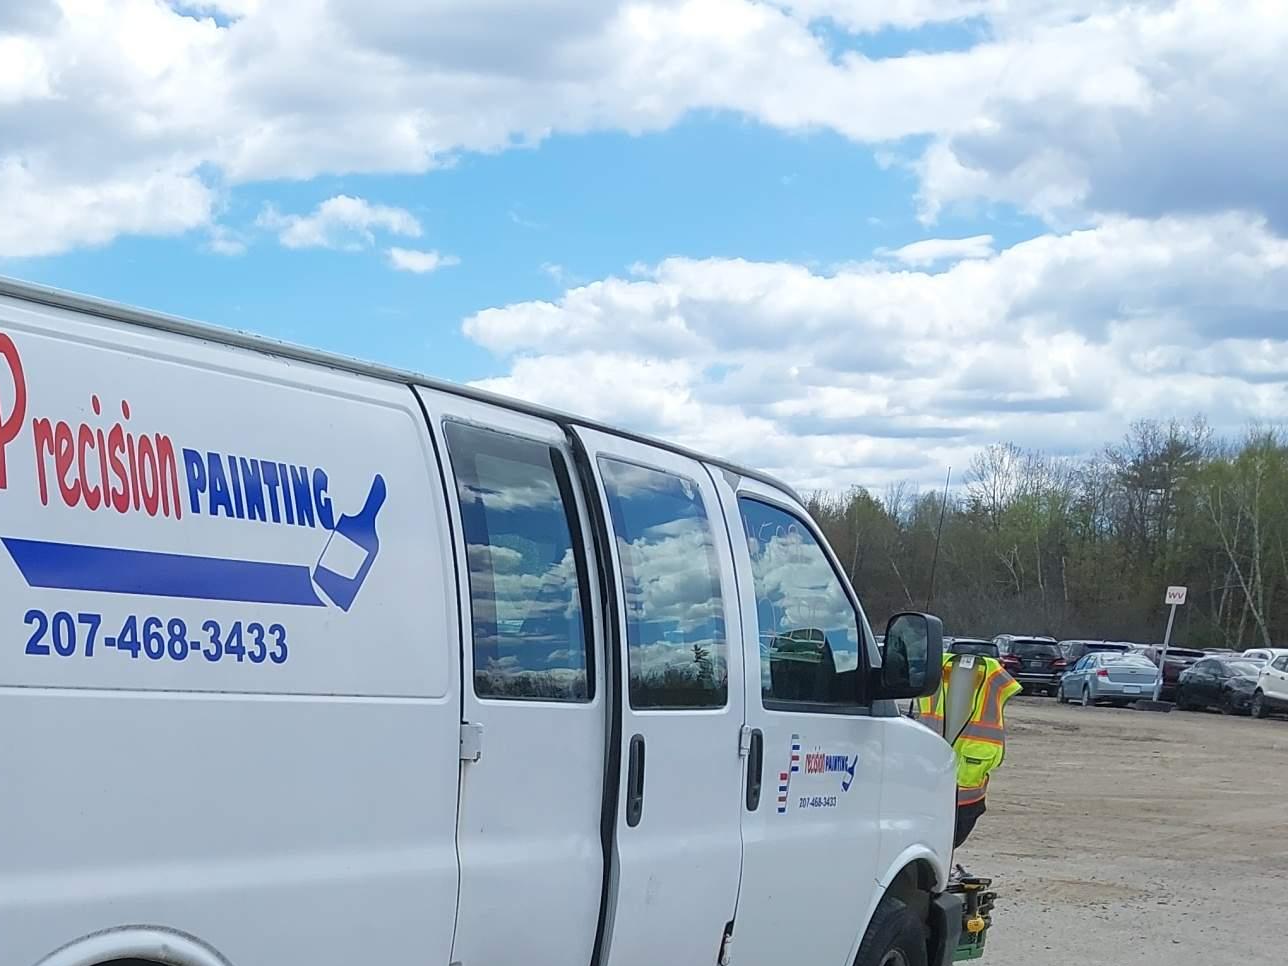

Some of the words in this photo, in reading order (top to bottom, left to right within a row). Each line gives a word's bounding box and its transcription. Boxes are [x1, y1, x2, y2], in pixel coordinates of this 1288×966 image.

[182, 447, 336, 532] PAINTING
[23, 608, 290, 666] 207-468-3433
[799, 796, 837, 809] 207-468-3433
